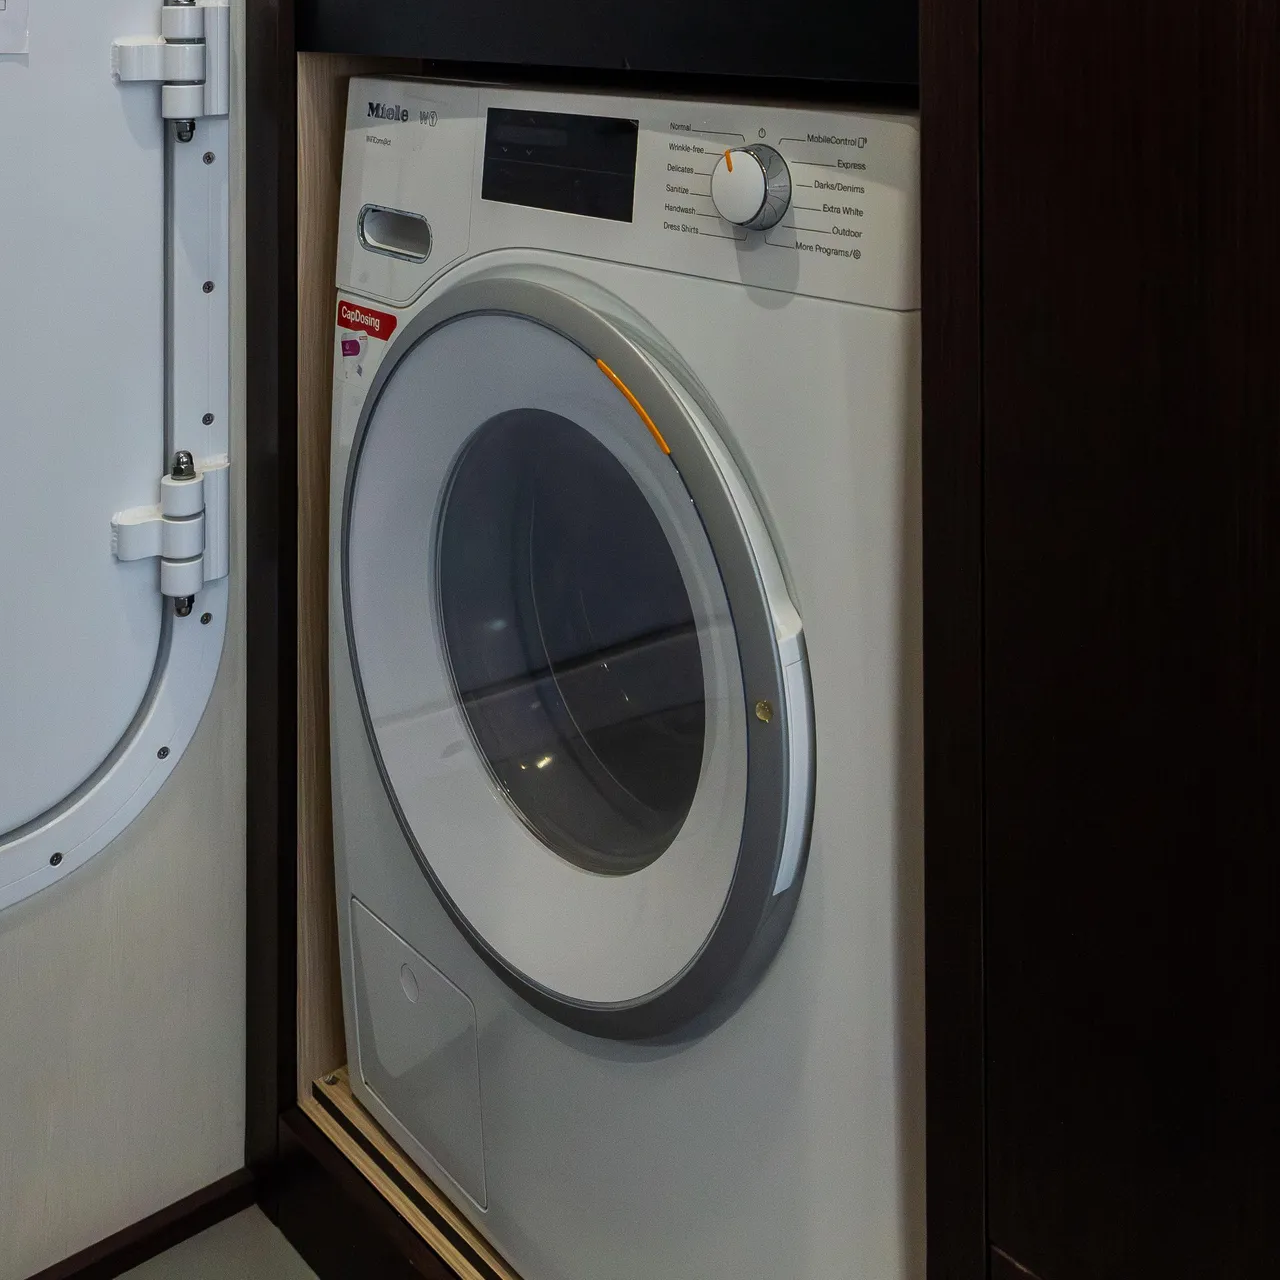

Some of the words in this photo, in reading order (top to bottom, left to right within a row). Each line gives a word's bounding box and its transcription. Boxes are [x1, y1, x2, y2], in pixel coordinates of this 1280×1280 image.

[368, 102, 408, 122] Miele
[670, 122, 691, 132] Normal
[807, 134, 857, 146] MobileControl
[669, 143, 704, 154] Wrinkle-free
[667, 164, 694, 174] Delicates
[837, 160, 866, 171] Express
[666, 184, 689, 194] Sanitize
[814, 180, 865, 194] Darks/Denims
[664, 203, 695, 215] Handwash
[823, 204, 841, 214] Extra
[842, 205, 864, 217] White
[664, 222, 680, 231] Dress
[681, 224, 698, 234] Shirts
[832, 226, 863, 238] Outdoor
[795, 242, 813, 252] More
[341, 306, 380, 331] CapDosing
